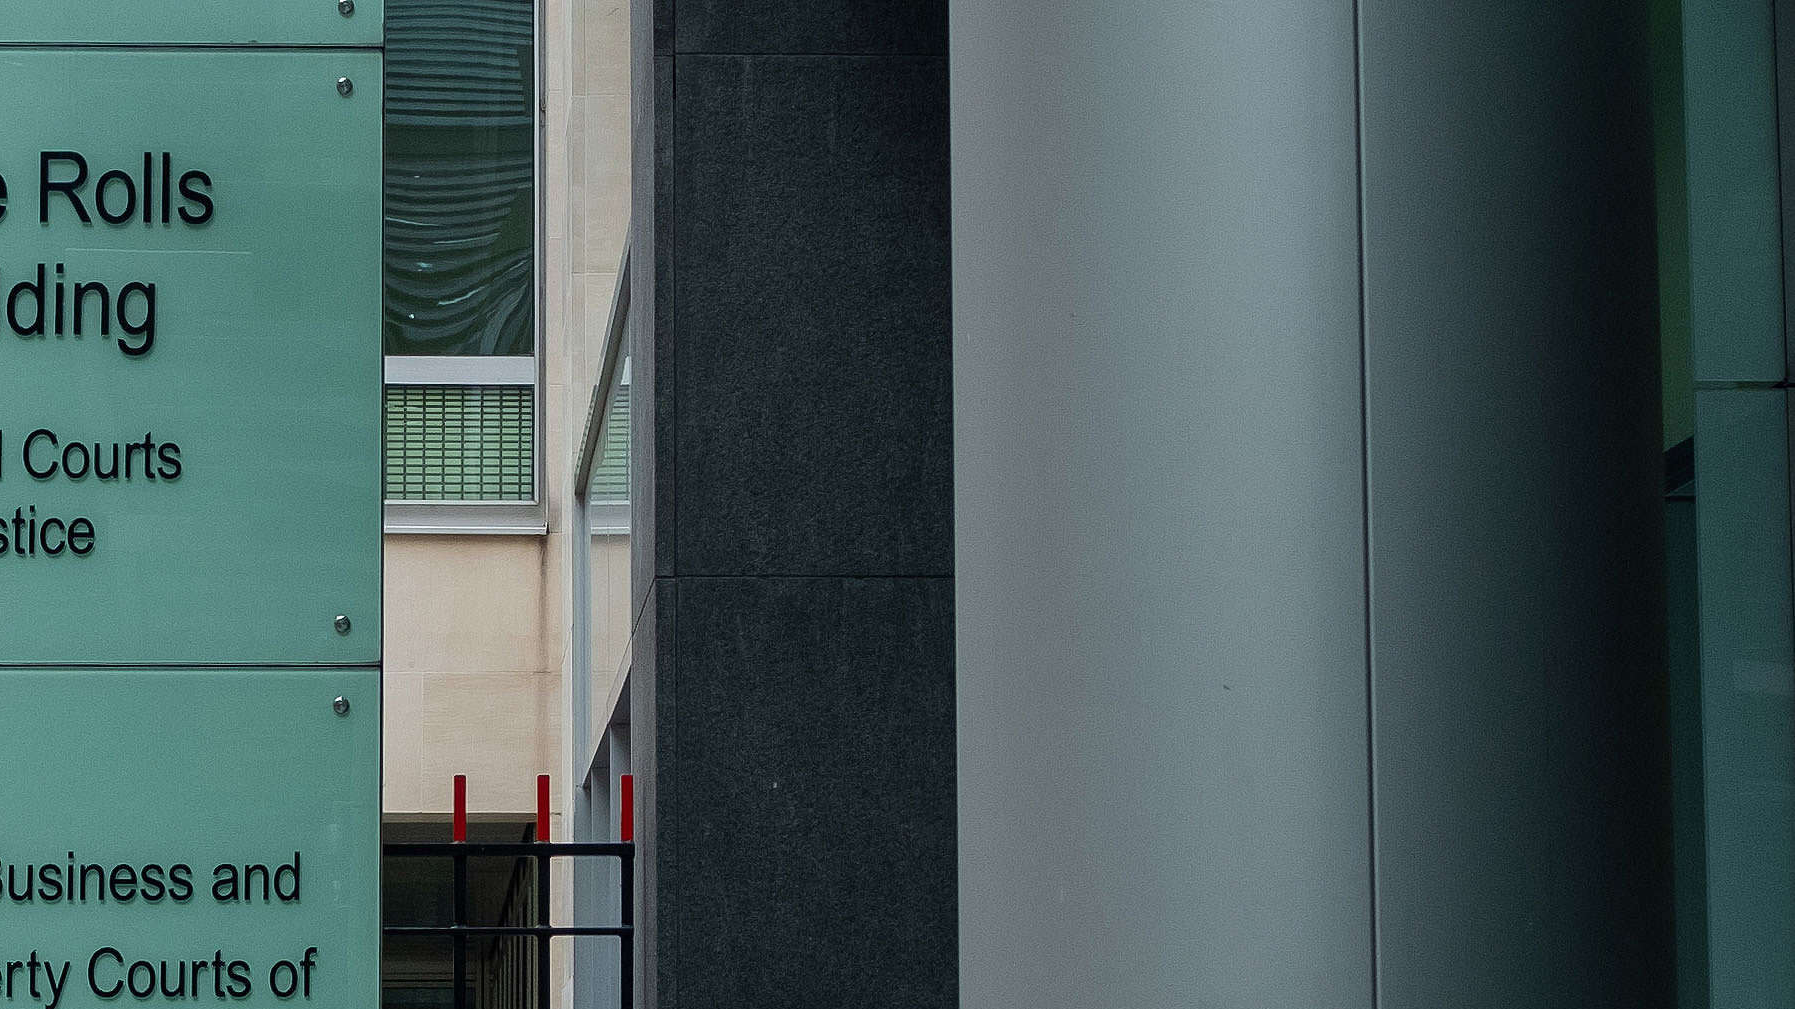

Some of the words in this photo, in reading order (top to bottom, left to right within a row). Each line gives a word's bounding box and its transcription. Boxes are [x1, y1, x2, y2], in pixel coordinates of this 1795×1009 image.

[39, 151, 215, 225] Rolls
[22, 428, 183, 481] Courts
[211, 851, 302, 902] and
[87, 947, 253, 1000] Courts
[269, 947, 318, 999] of
